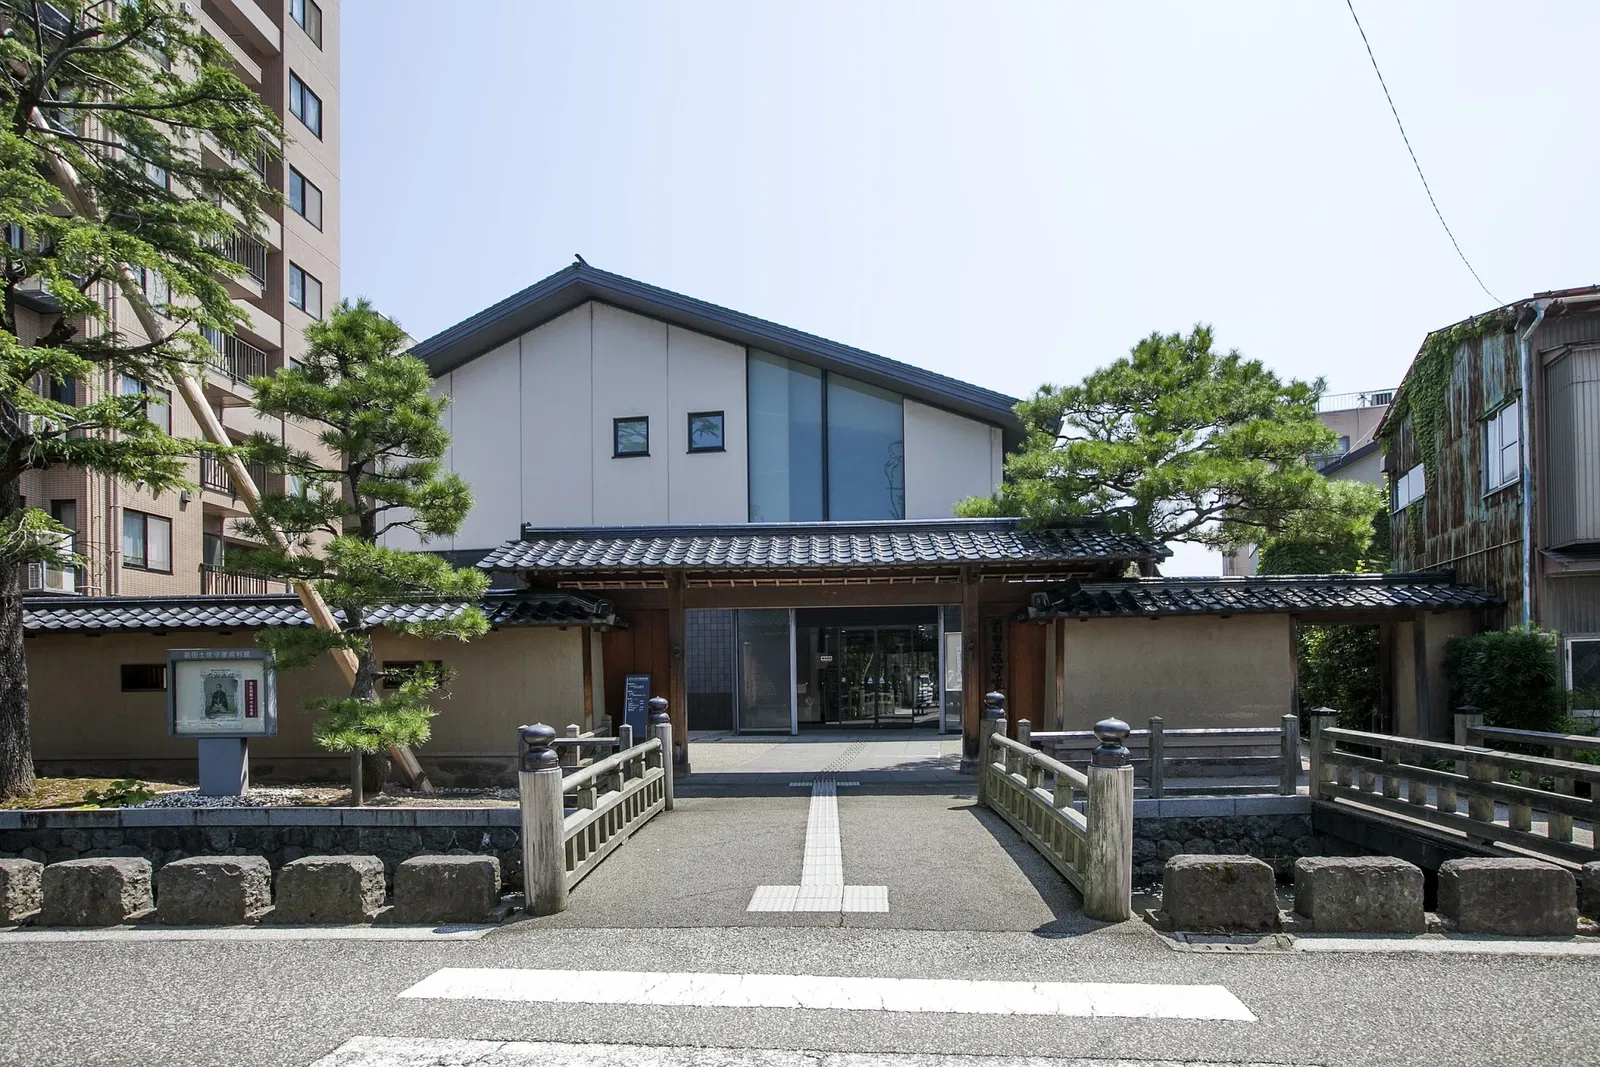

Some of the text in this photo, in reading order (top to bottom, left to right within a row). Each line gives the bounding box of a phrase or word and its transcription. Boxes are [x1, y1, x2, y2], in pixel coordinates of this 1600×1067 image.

[184, 651, 251, 659] 前田土佐守家資料館
